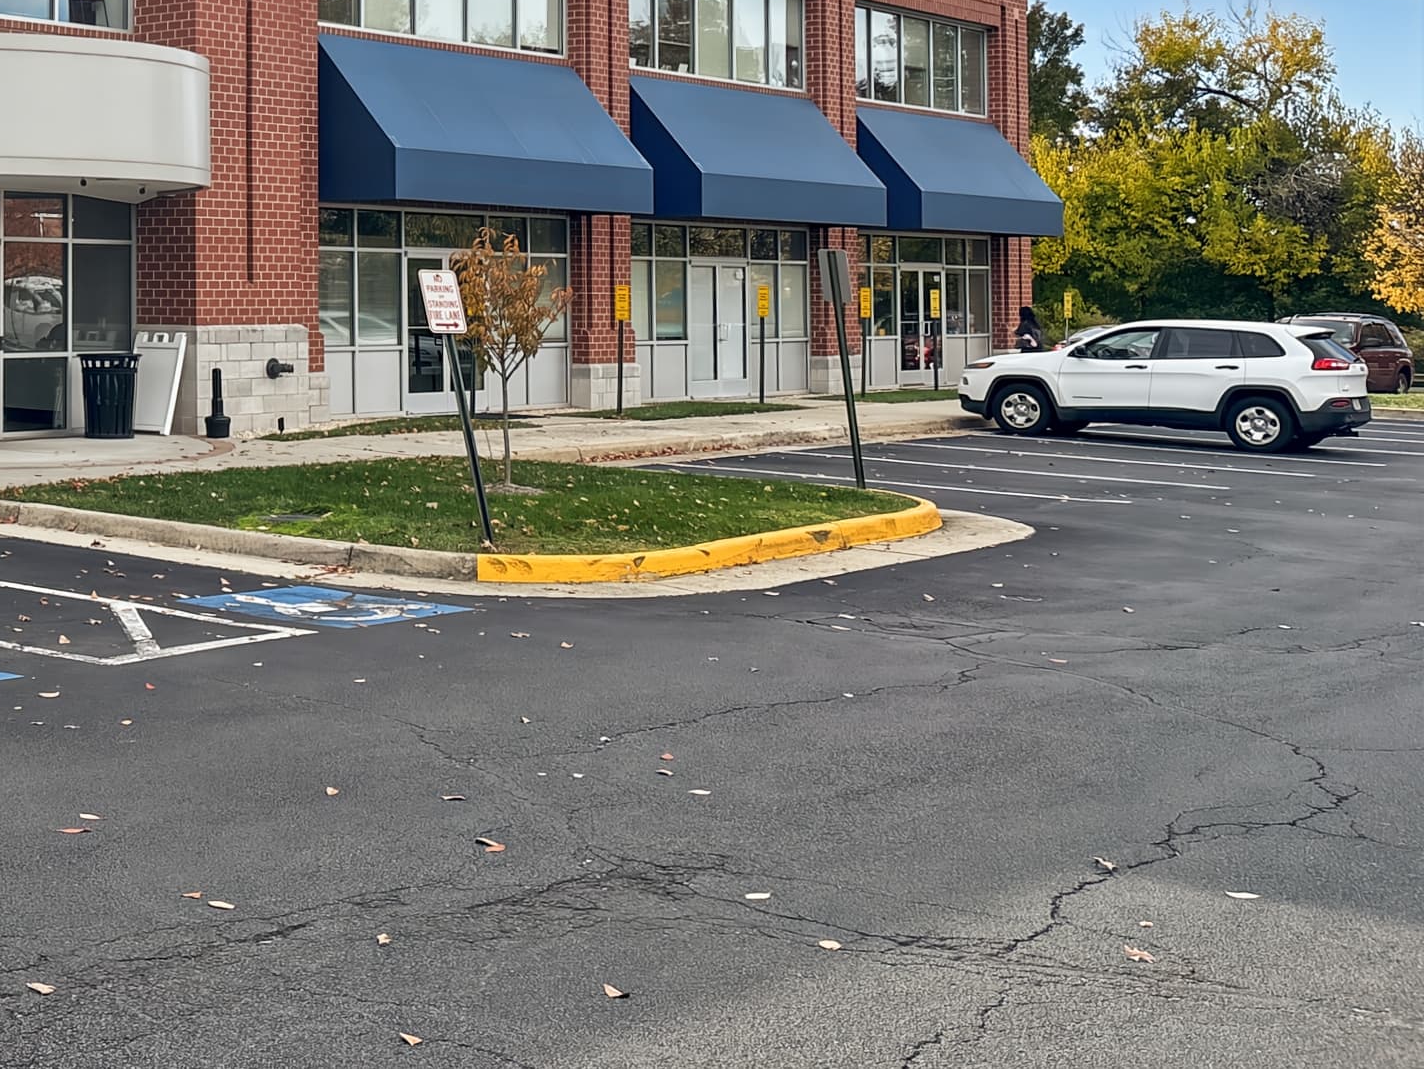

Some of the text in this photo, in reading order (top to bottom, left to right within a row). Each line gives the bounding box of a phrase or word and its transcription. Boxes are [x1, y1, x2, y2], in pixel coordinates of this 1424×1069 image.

[433, 274, 443, 282] NO
[426, 284, 454, 293] PARKING
[428, 300, 458, 308] STANDING
[444, 310, 461, 320] LANE
